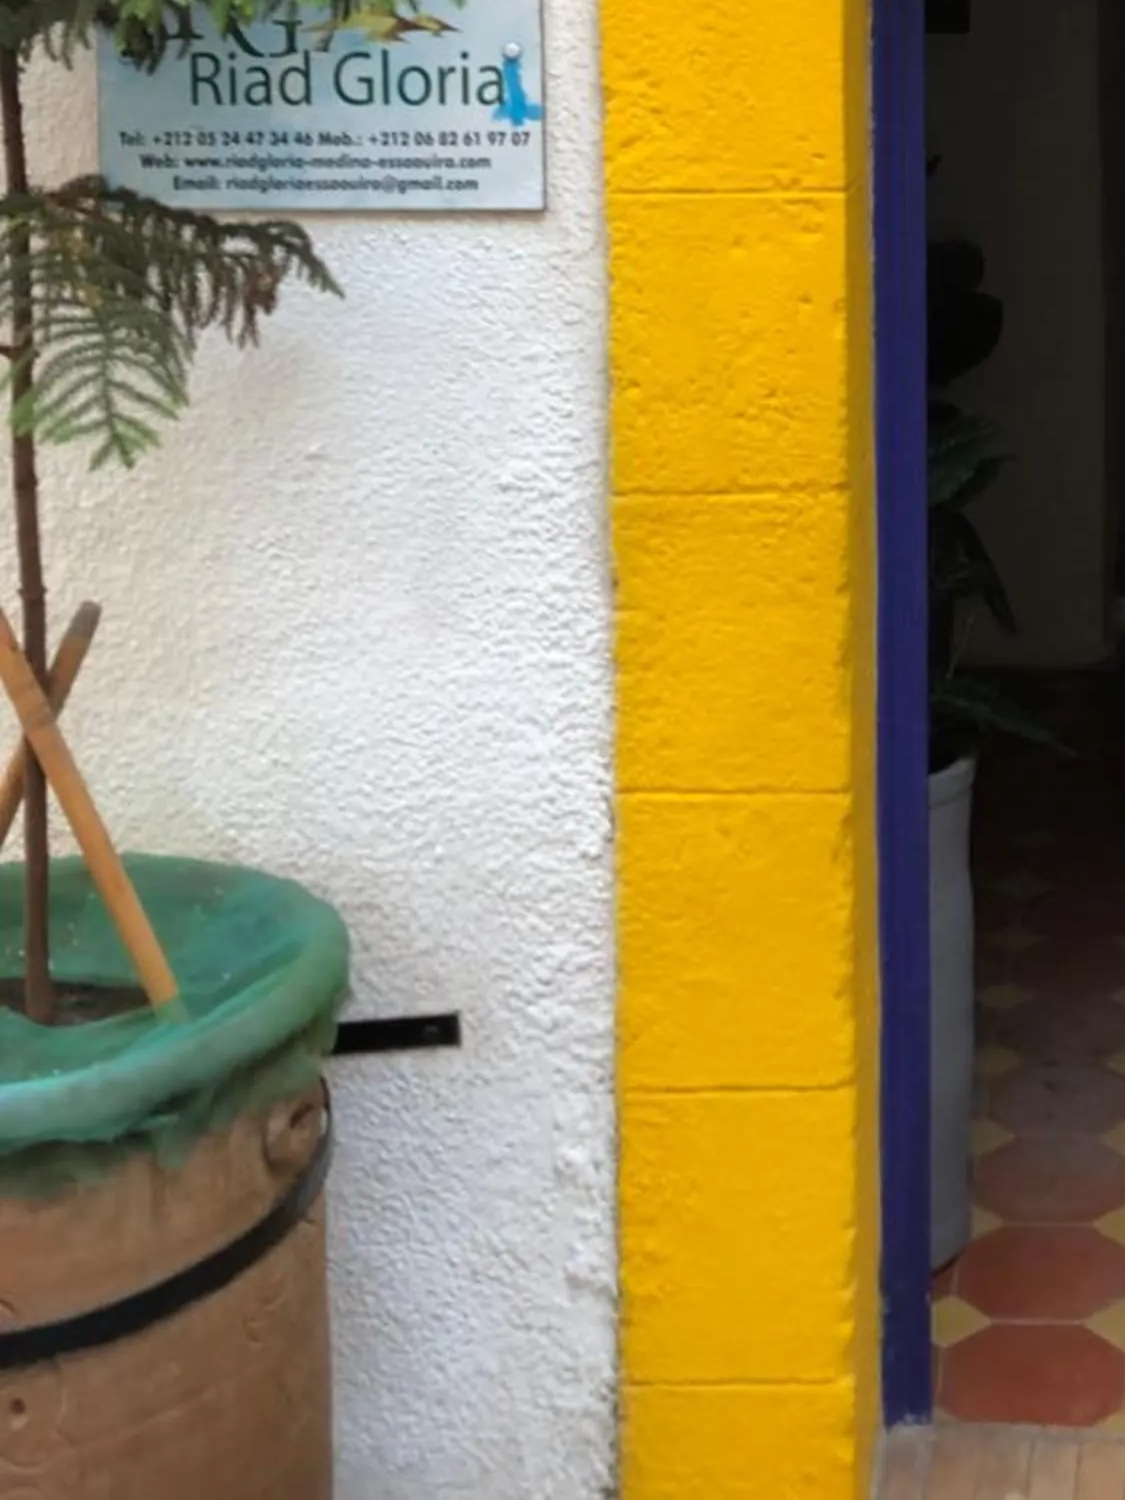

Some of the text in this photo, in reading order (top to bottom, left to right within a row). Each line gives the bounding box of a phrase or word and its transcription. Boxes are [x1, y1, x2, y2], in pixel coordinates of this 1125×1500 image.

[190, 48, 506, 106] Riad Gloria
[118, 131, 146, 146] Tel:
[152, 131, 193, 146] +212
[197, 131, 216, 146] 05
[221, 131, 240, 146] 24
[368, 131, 411, 146] +212
[413, 131, 435, 146] 06
[438, 131, 459, 146] 82
[462, 131, 481, 146] 61
[487, 131, 507, 146] 97
[510, 131, 531, 146] 07
[173, 175, 222, 191] Email:
